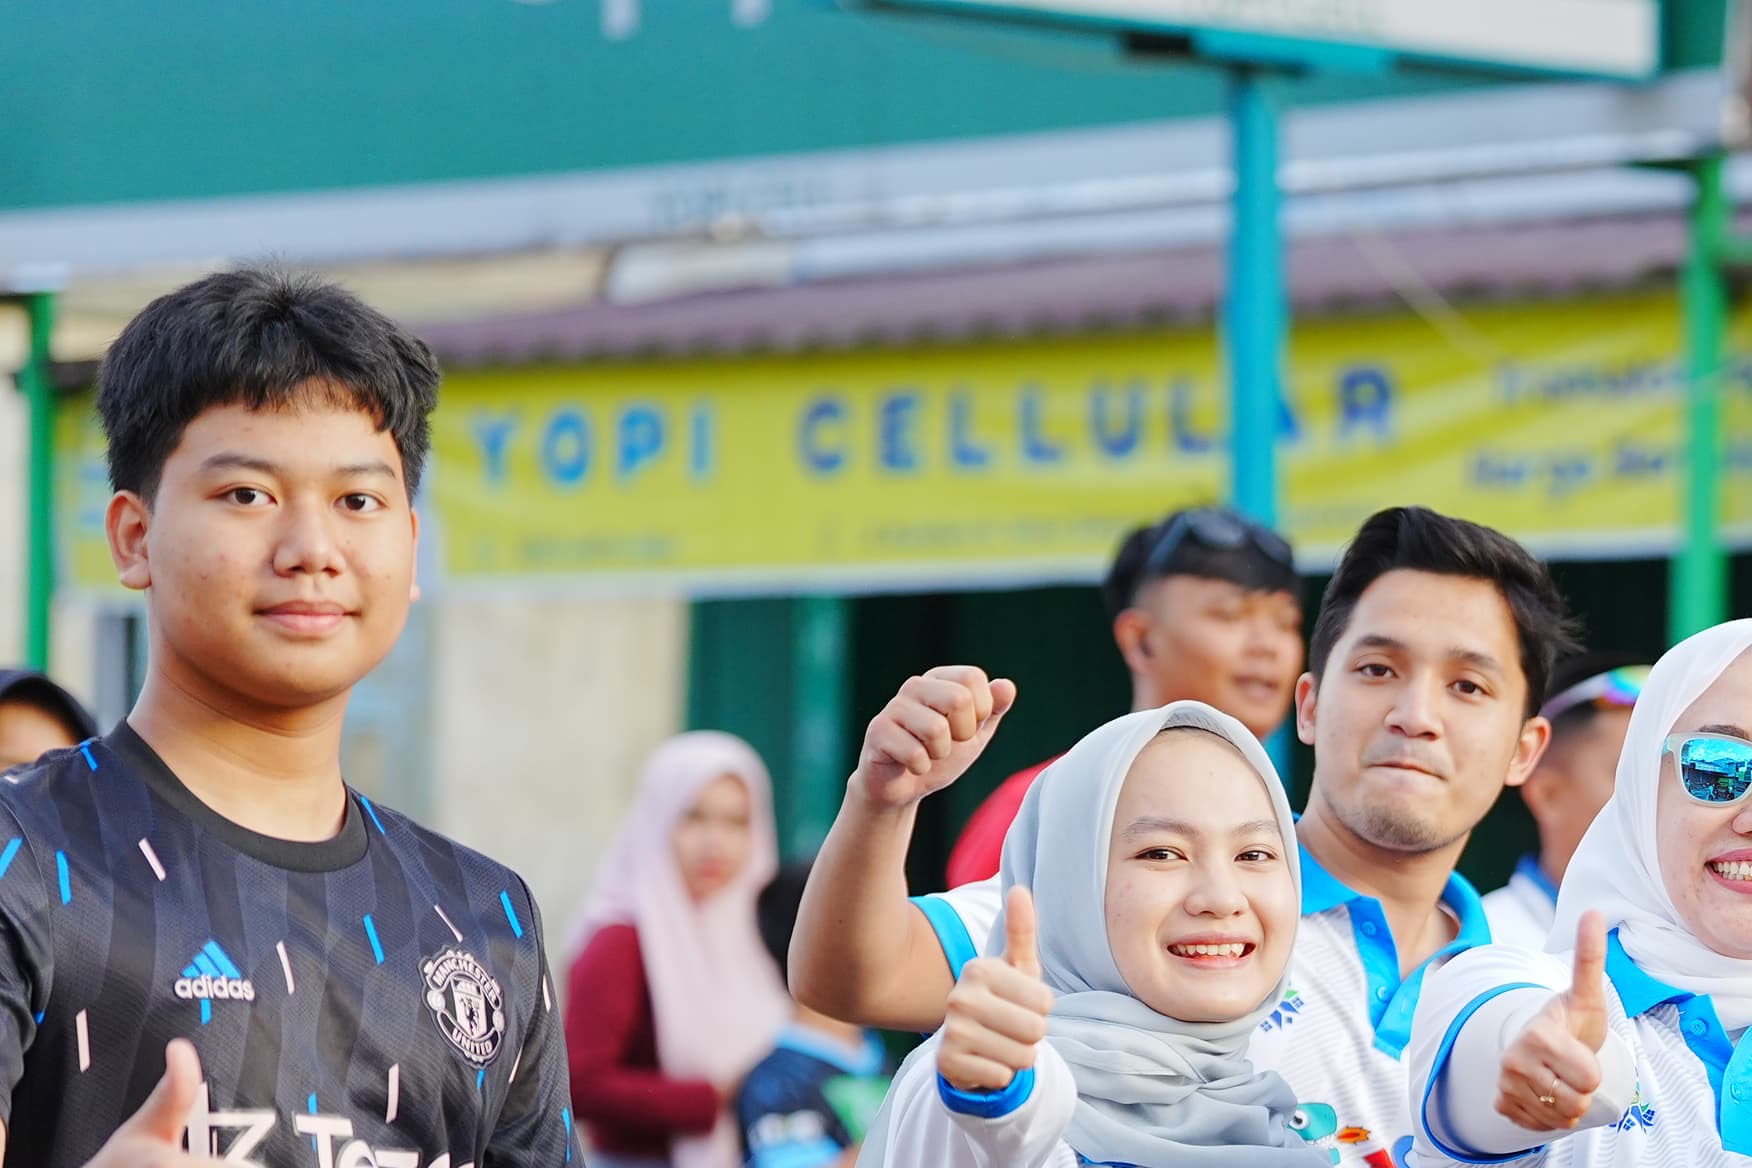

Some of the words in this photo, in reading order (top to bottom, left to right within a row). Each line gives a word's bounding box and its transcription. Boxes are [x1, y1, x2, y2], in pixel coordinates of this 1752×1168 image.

[470, 403, 717, 490] YOPI
[174, 973, 256, 1001] adidas
[432, 957, 498, 1004] MANCHESTER
